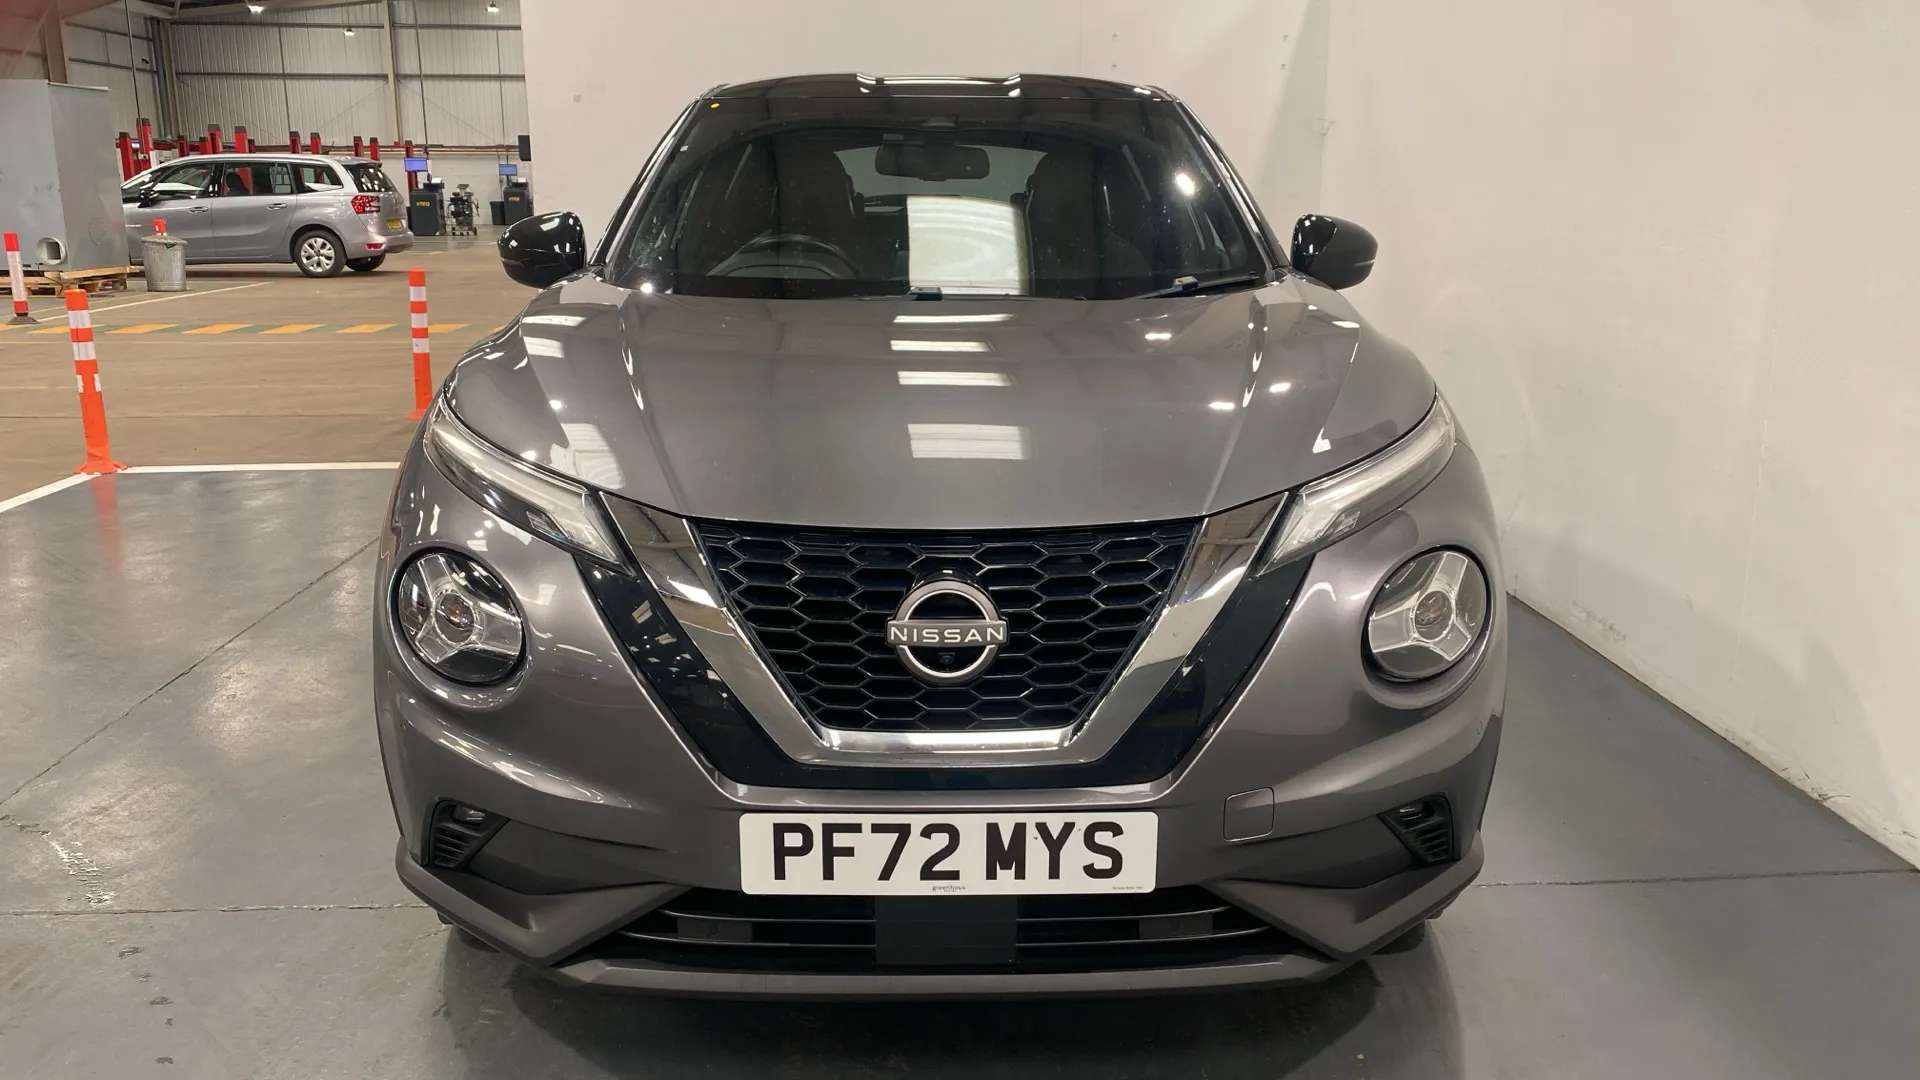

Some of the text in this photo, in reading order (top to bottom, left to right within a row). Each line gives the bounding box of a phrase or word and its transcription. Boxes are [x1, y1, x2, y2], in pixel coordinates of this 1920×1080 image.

[890, 626, 1004, 643] NISSAN
[772, 821, 1124, 881] PF72 MYS
